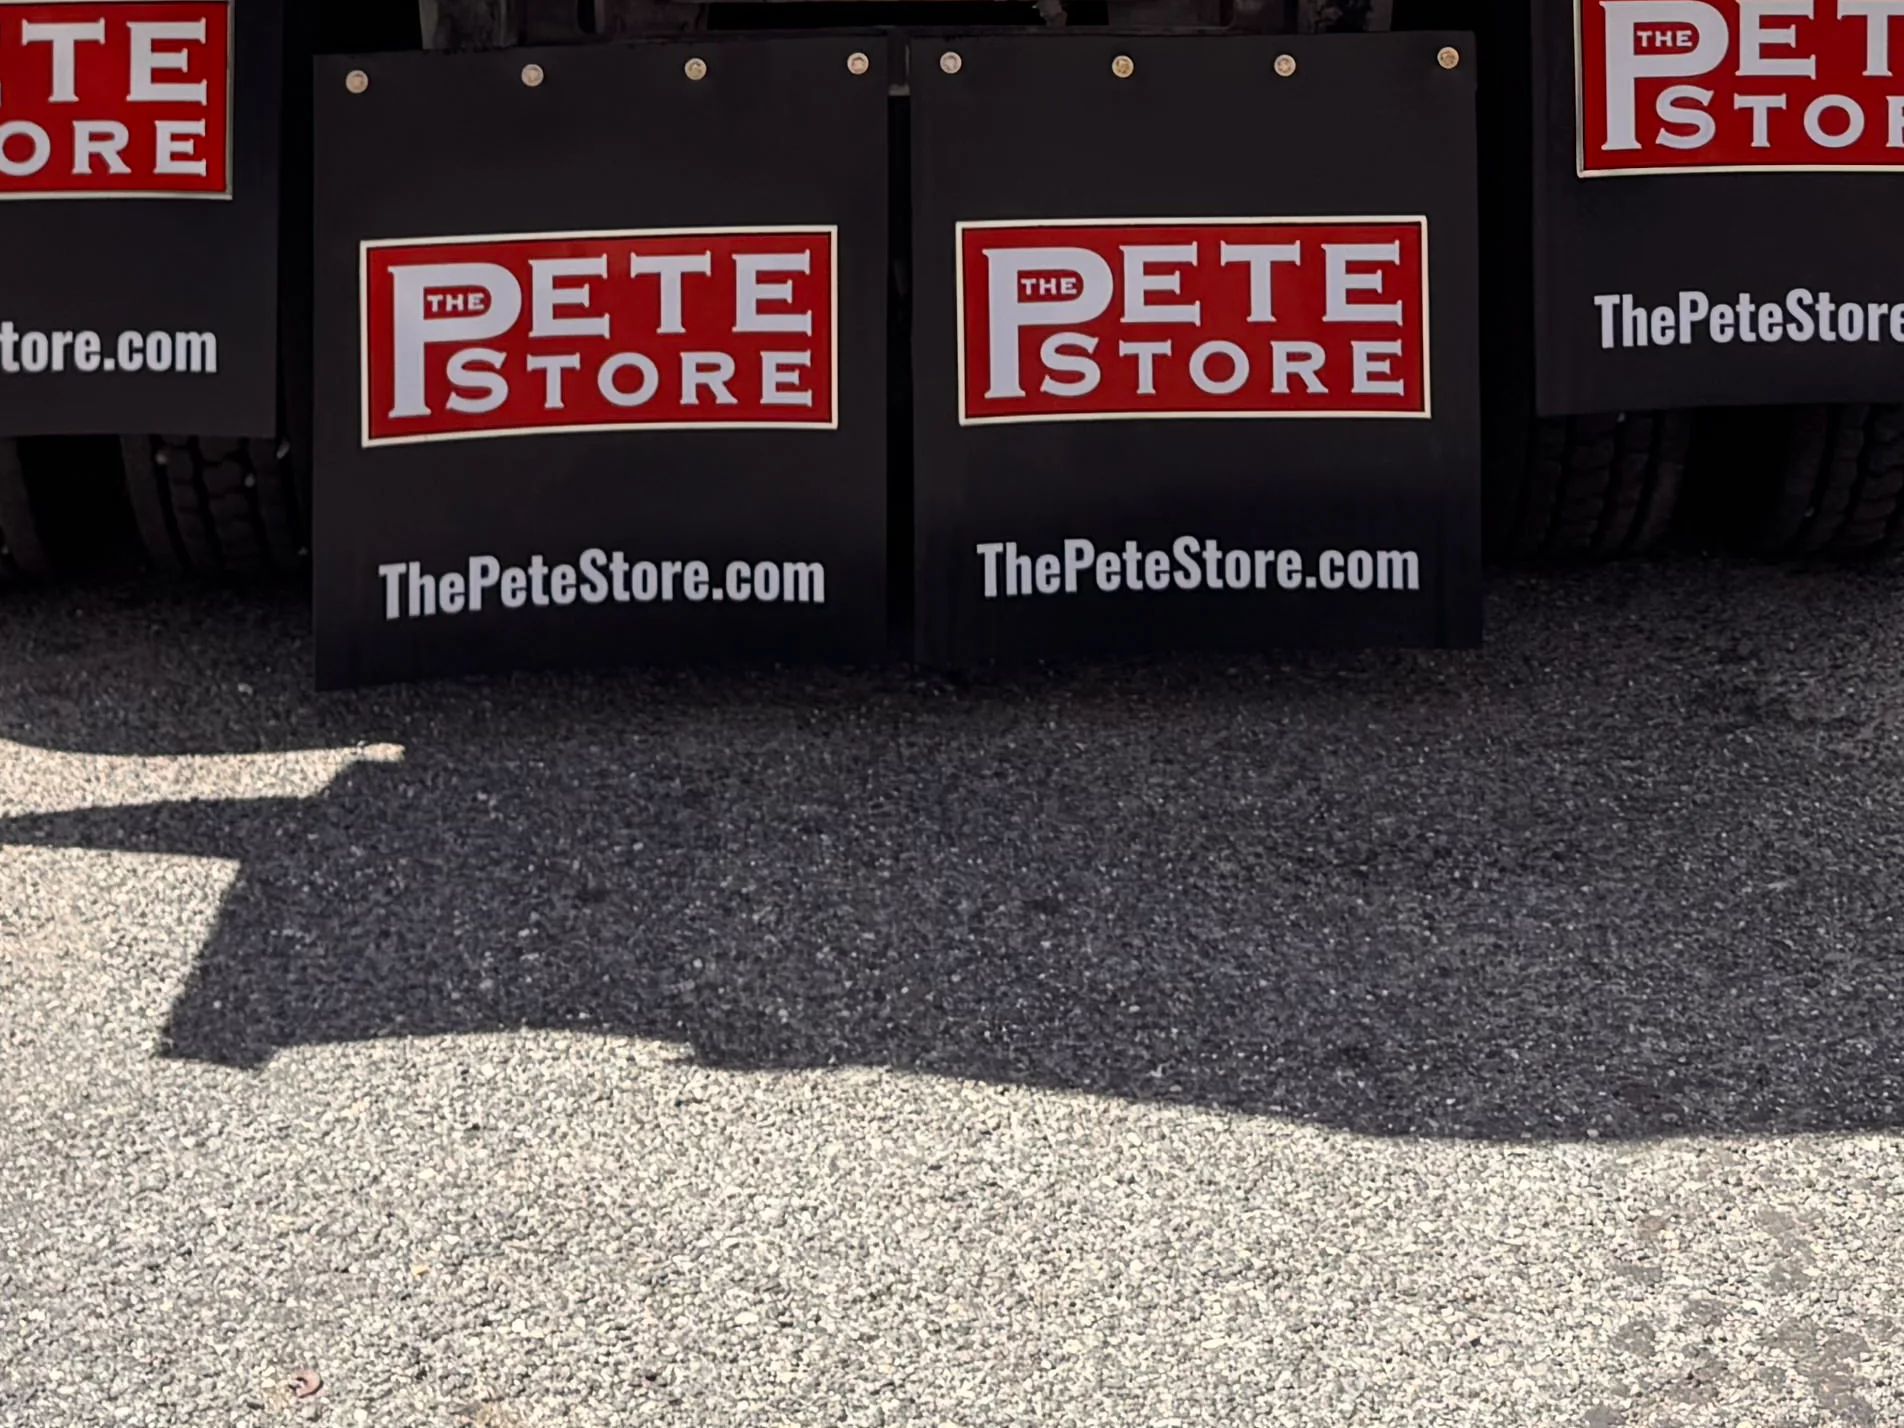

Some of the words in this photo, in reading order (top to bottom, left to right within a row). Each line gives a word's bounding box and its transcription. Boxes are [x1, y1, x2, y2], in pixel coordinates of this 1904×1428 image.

[1636, 30, 1693, 47] THE
[426, 292, 485, 312] THE
[982, 239, 1403, 399] PETE
[1020, 277, 1077, 295] THE
[387, 249, 812, 418] PETE
[1040, 331, 1404, 397] STORE
[446, 347, 813, 413] STORE
[378, 548, 825, 619] ThePeteStore.com
[976, 535, 1419, 597] ThePeteStore.com
